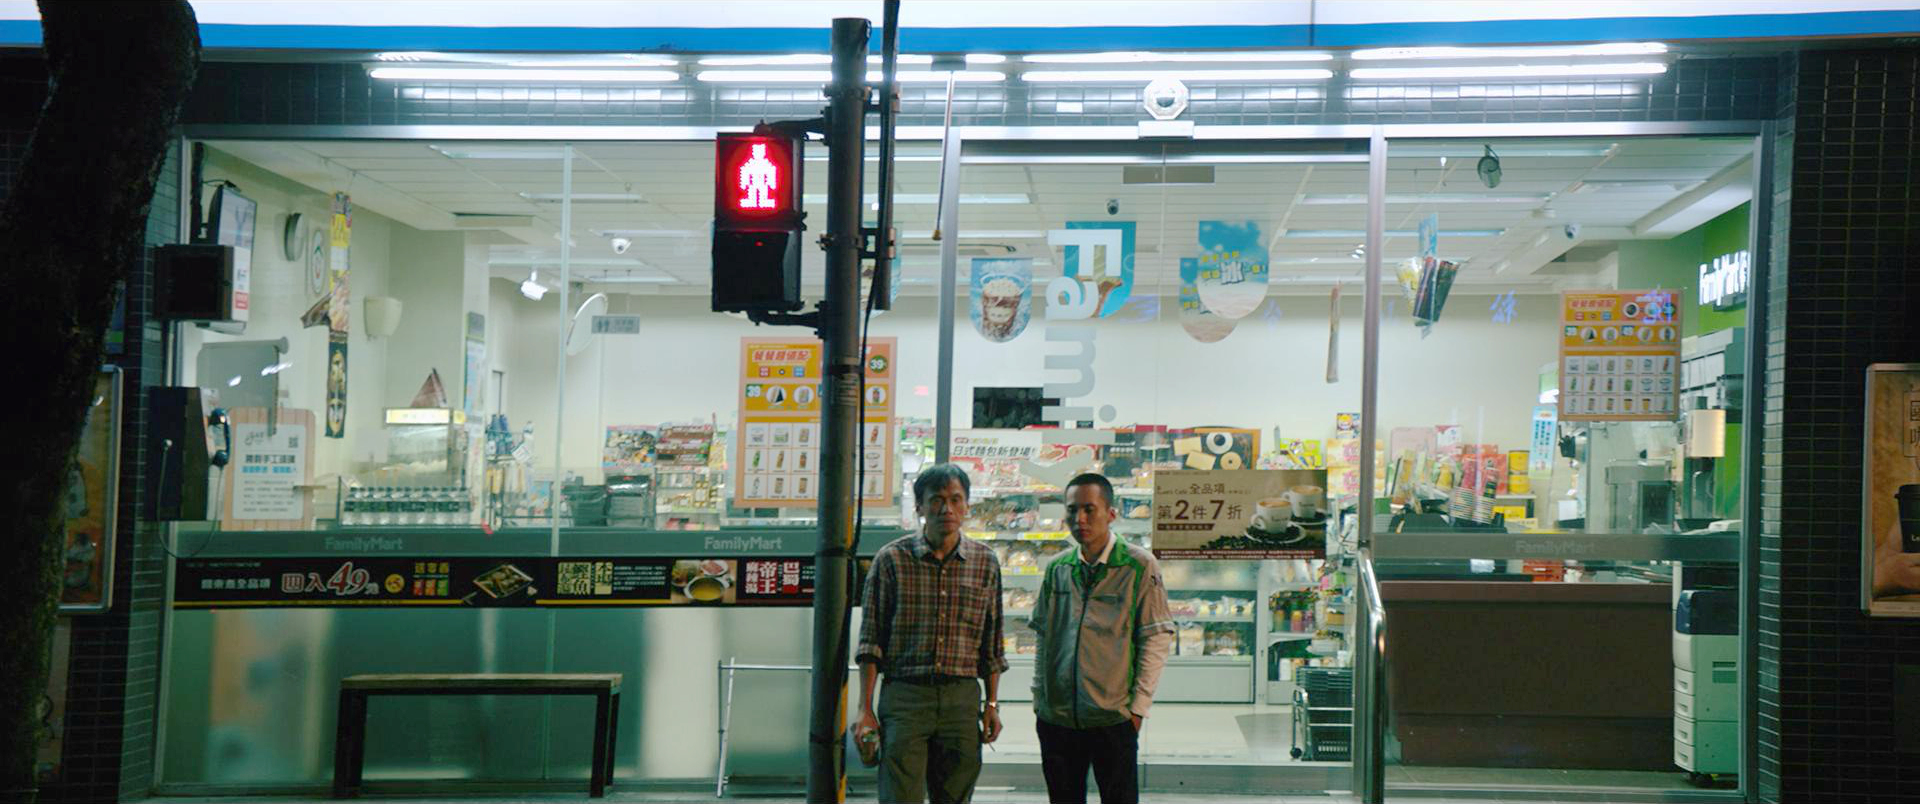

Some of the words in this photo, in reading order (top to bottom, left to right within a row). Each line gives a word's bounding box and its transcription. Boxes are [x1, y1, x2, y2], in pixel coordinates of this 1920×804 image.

[870, 359, 884, 369] 39
[1157, 499, 1242, 520] 第2件7折
[324, 536, 402, 551] FamilyMart
[704, 536, 783, 551] FamilyMart
